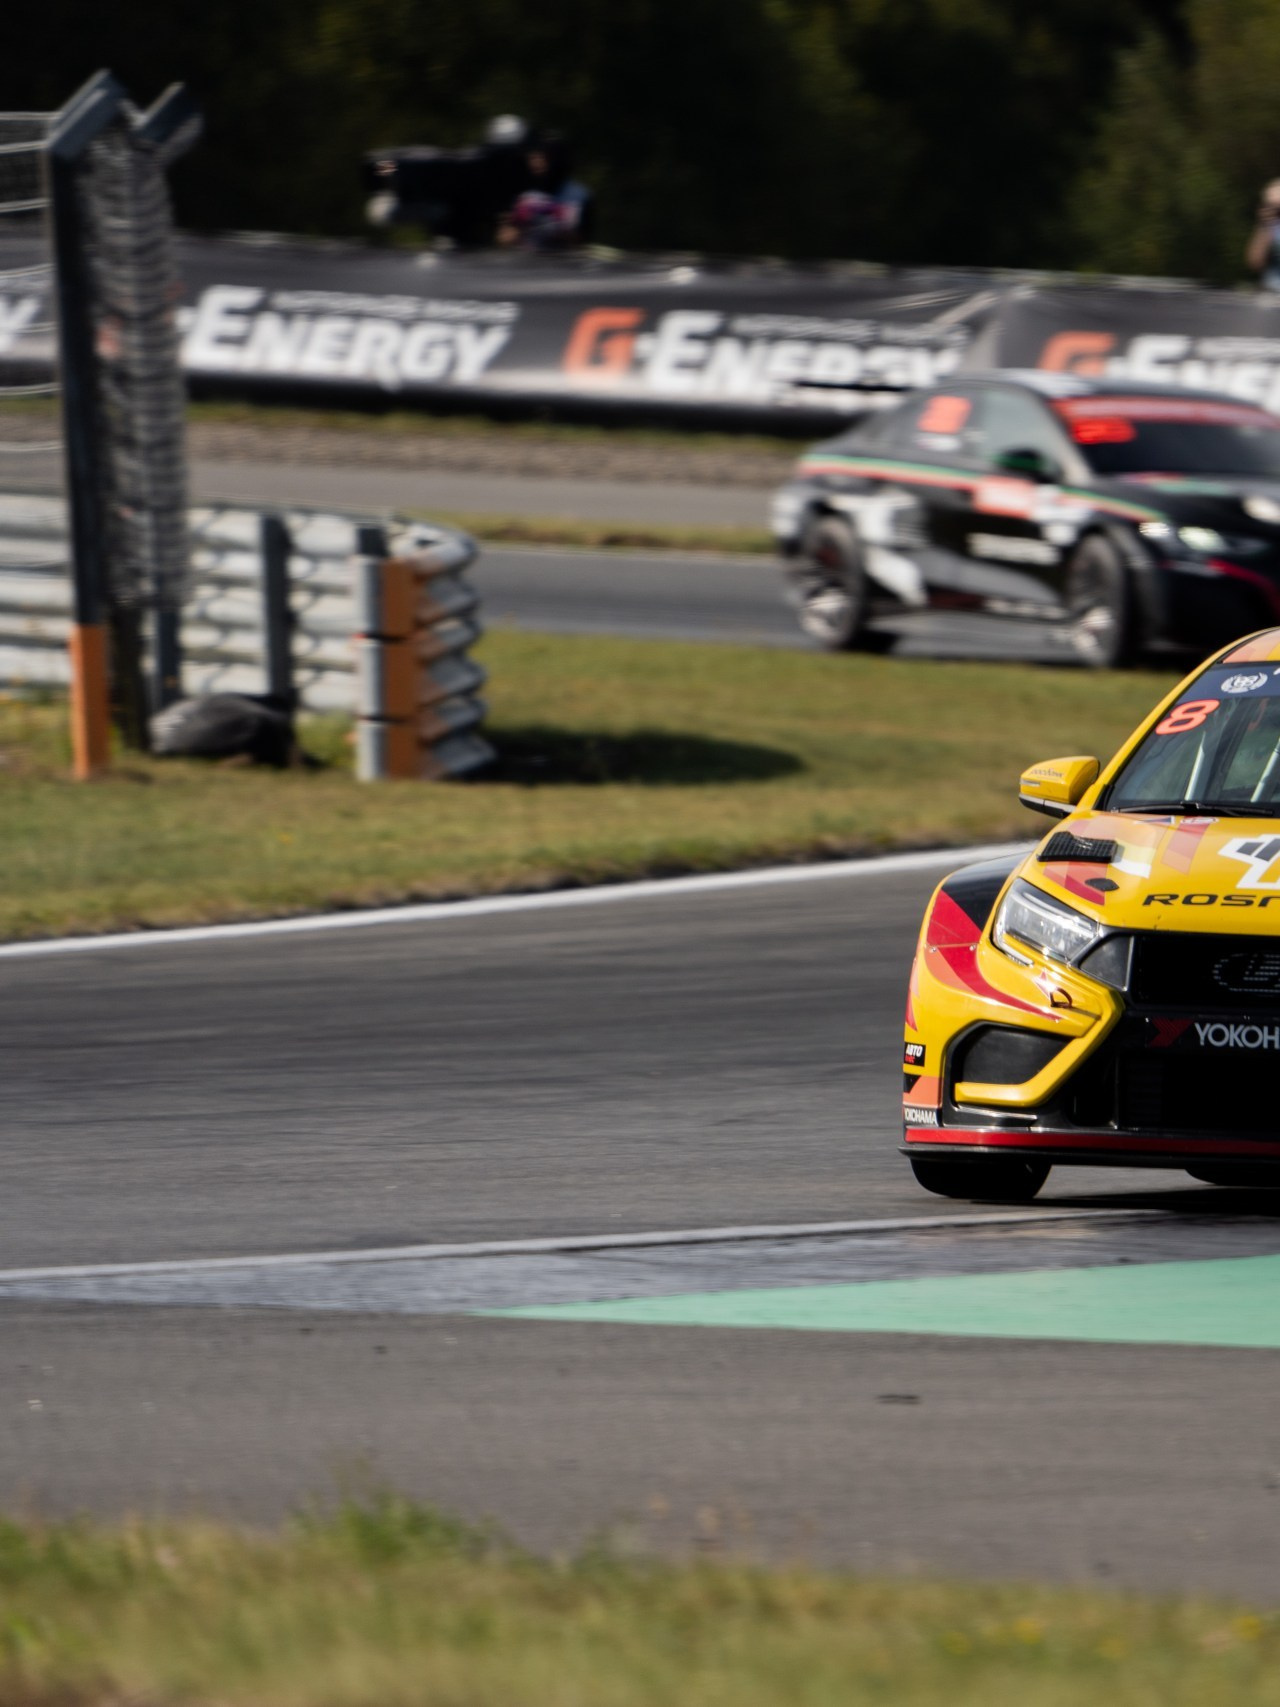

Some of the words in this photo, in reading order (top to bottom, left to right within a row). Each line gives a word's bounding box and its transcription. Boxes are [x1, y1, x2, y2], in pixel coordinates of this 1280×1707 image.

[176, 285, 512, 392] -ENERGY
[1155, 699, 1220, 735] 8
[904, 1108, 939, 1127] OKOHAMA
